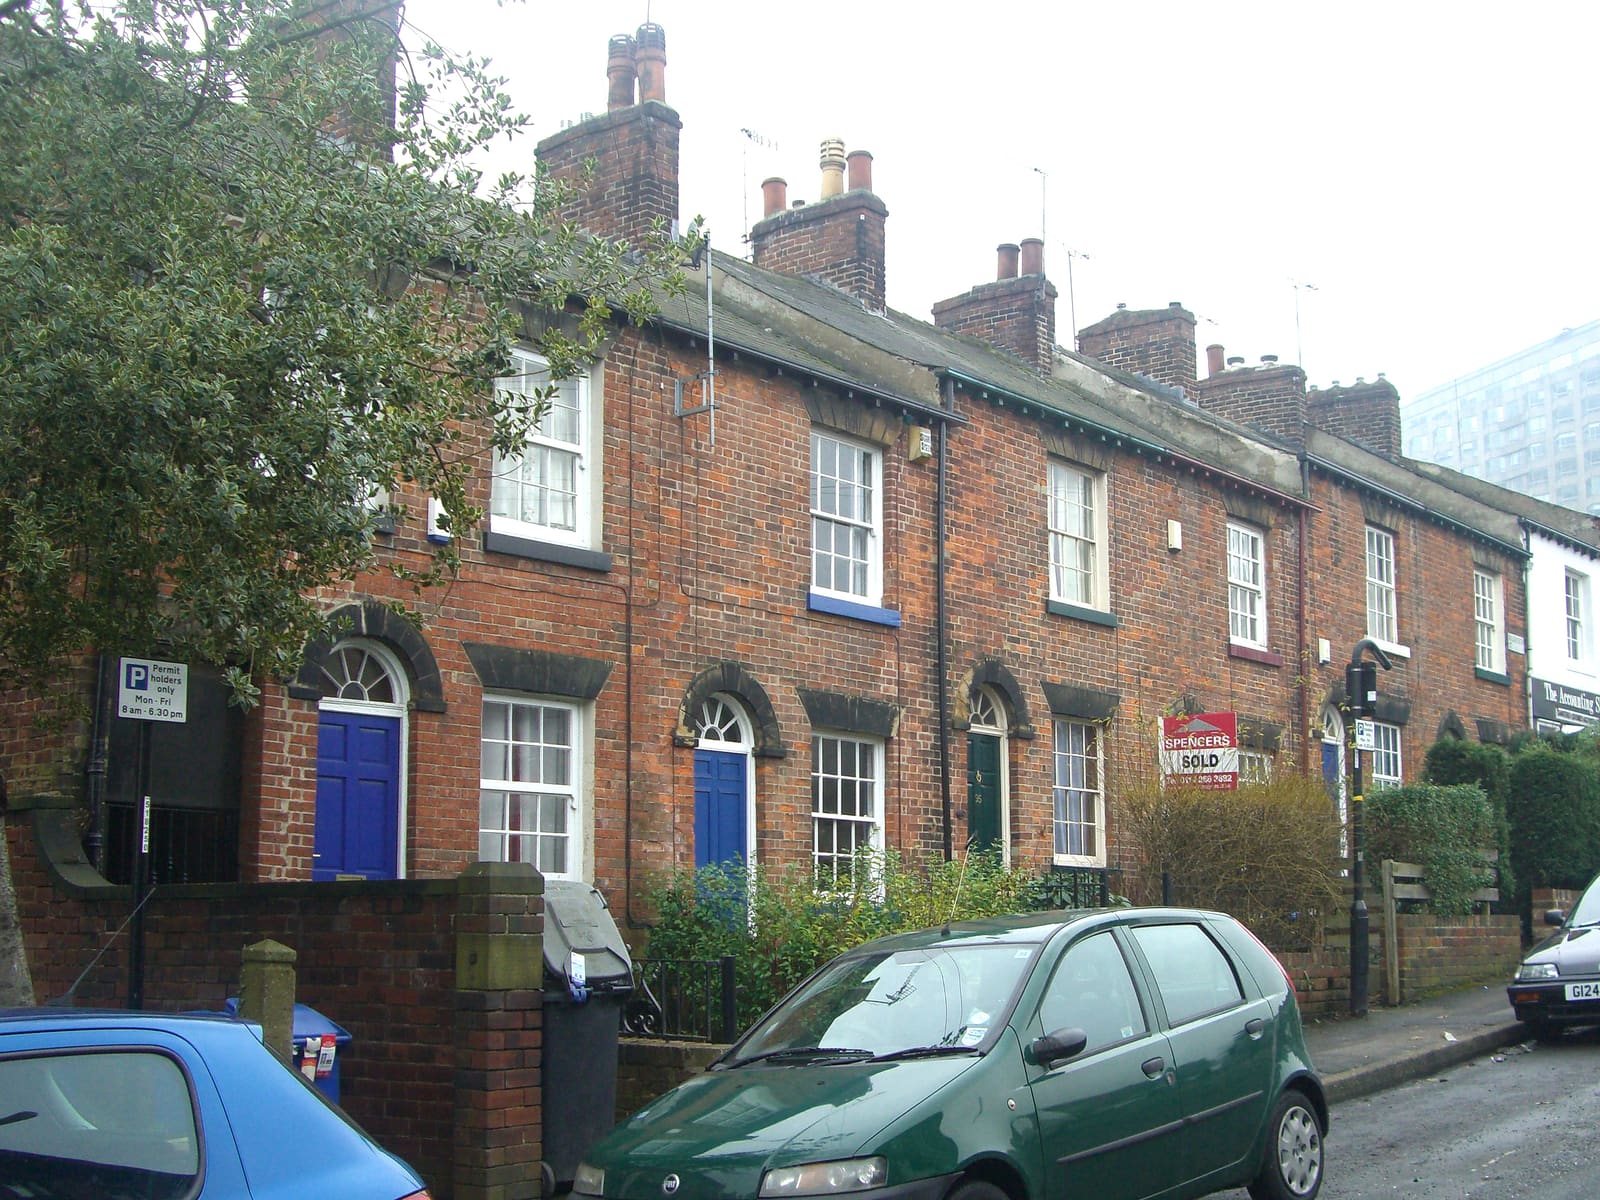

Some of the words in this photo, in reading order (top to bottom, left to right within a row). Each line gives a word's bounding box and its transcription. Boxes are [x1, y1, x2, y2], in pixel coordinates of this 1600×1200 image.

[153, 664, 180, 675] Permit
[131, 666, 146, 688] P
[151, 674, 182, 685] holders
[157, 686, 175, 695] only
[135, 695, 153, 704] Mon
[160, 697, 171, 706] Fri
[1543, 681, 1558, 702] The
[1559, 687, 1594, 715] Accounting
[1165, 735, 1230, 749] SPENCERS
[1182, 754, 1219, 768] SOLD
[1572, 984, 1600, 998] G124
